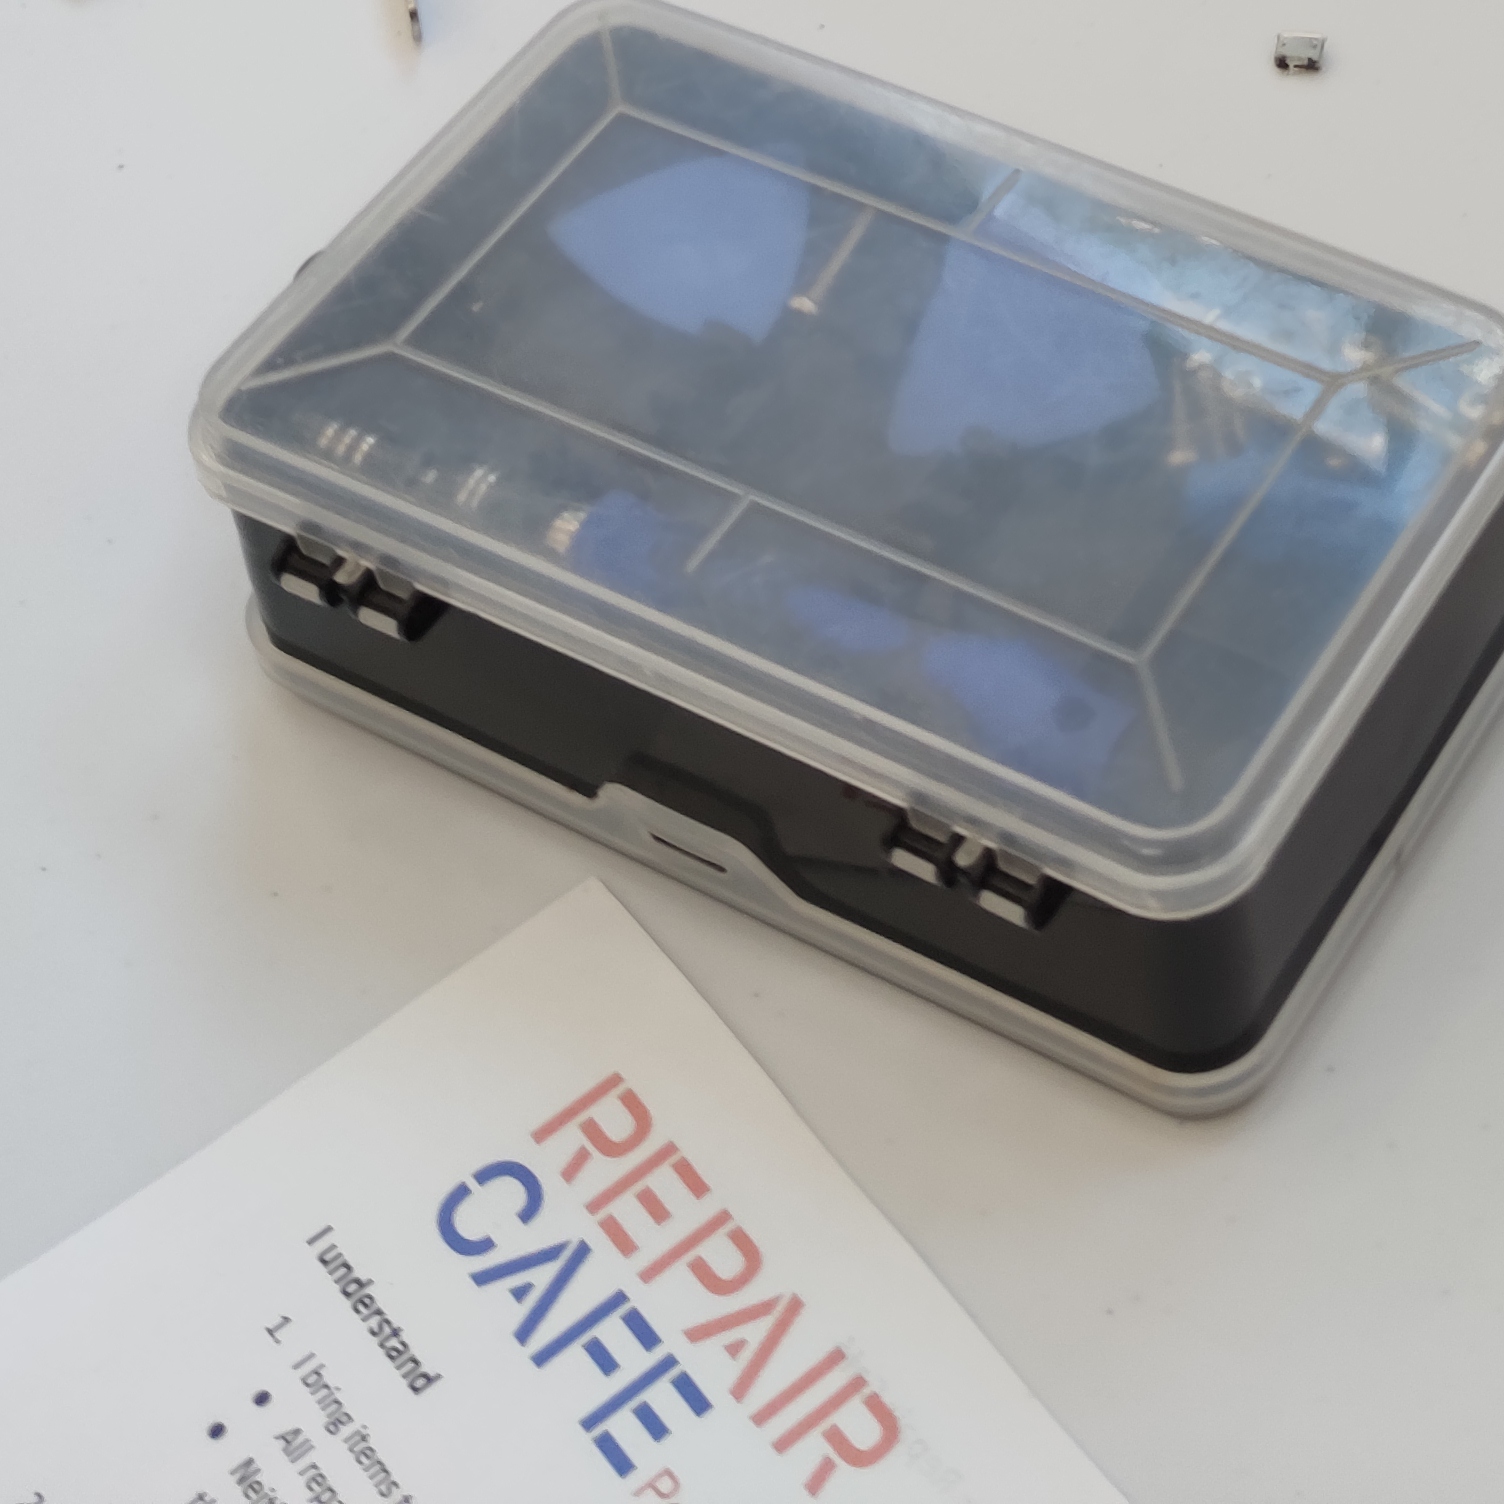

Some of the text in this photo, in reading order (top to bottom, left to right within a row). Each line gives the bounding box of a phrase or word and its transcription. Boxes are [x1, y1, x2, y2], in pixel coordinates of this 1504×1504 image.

[305, 1224, 444, 1395] I understand
[436, 1159, 713, 1479] CAFE
[530, 1071, 901, 1498] REPAIR
[292, 1351, 317, 1371] I
[300, 1363, 354, 1436] bring
[273, 1427, 316, 1464] All
[342, 1424, 401, 1499] items
